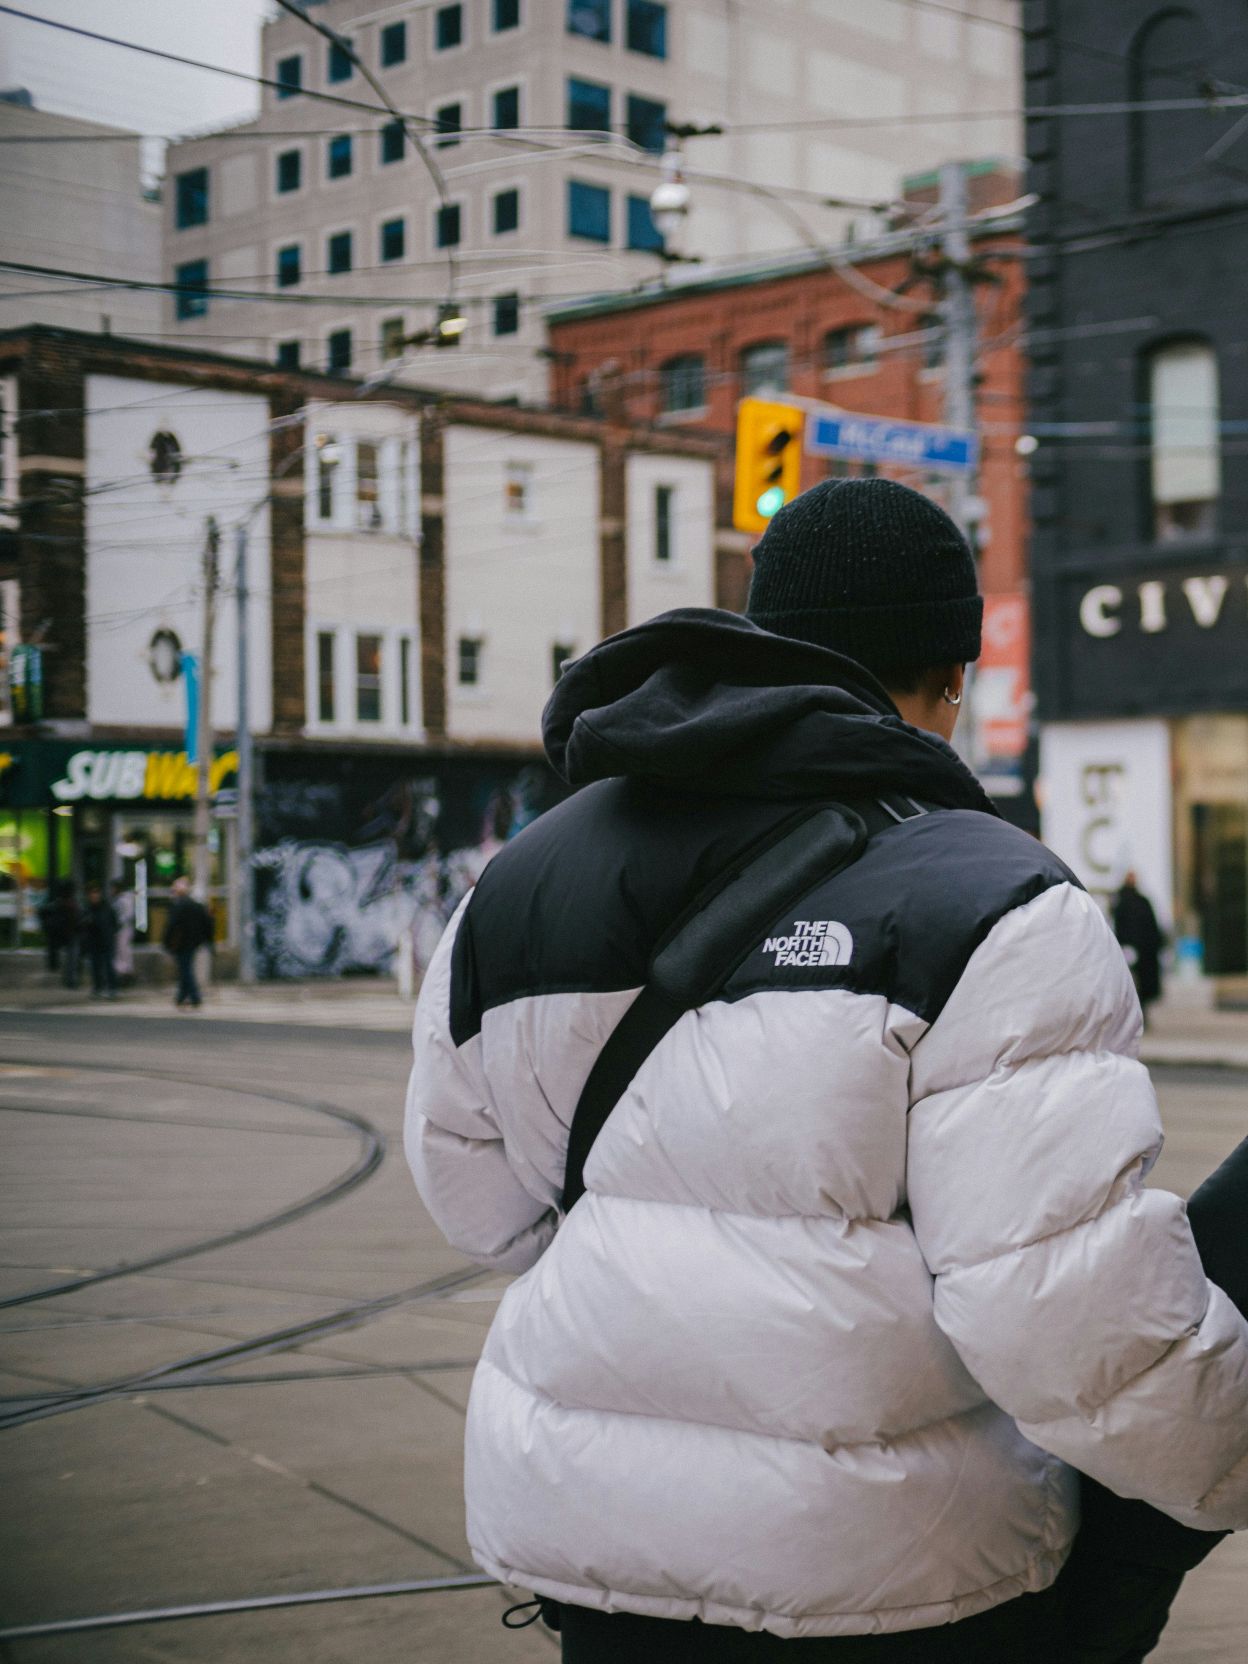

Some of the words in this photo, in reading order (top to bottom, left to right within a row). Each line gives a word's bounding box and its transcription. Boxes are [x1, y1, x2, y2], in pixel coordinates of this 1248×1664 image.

[793, 920, 828, 936] THE
[762, 935, 824, 953] NORTH
[774, 950, 822, 967] FACE
